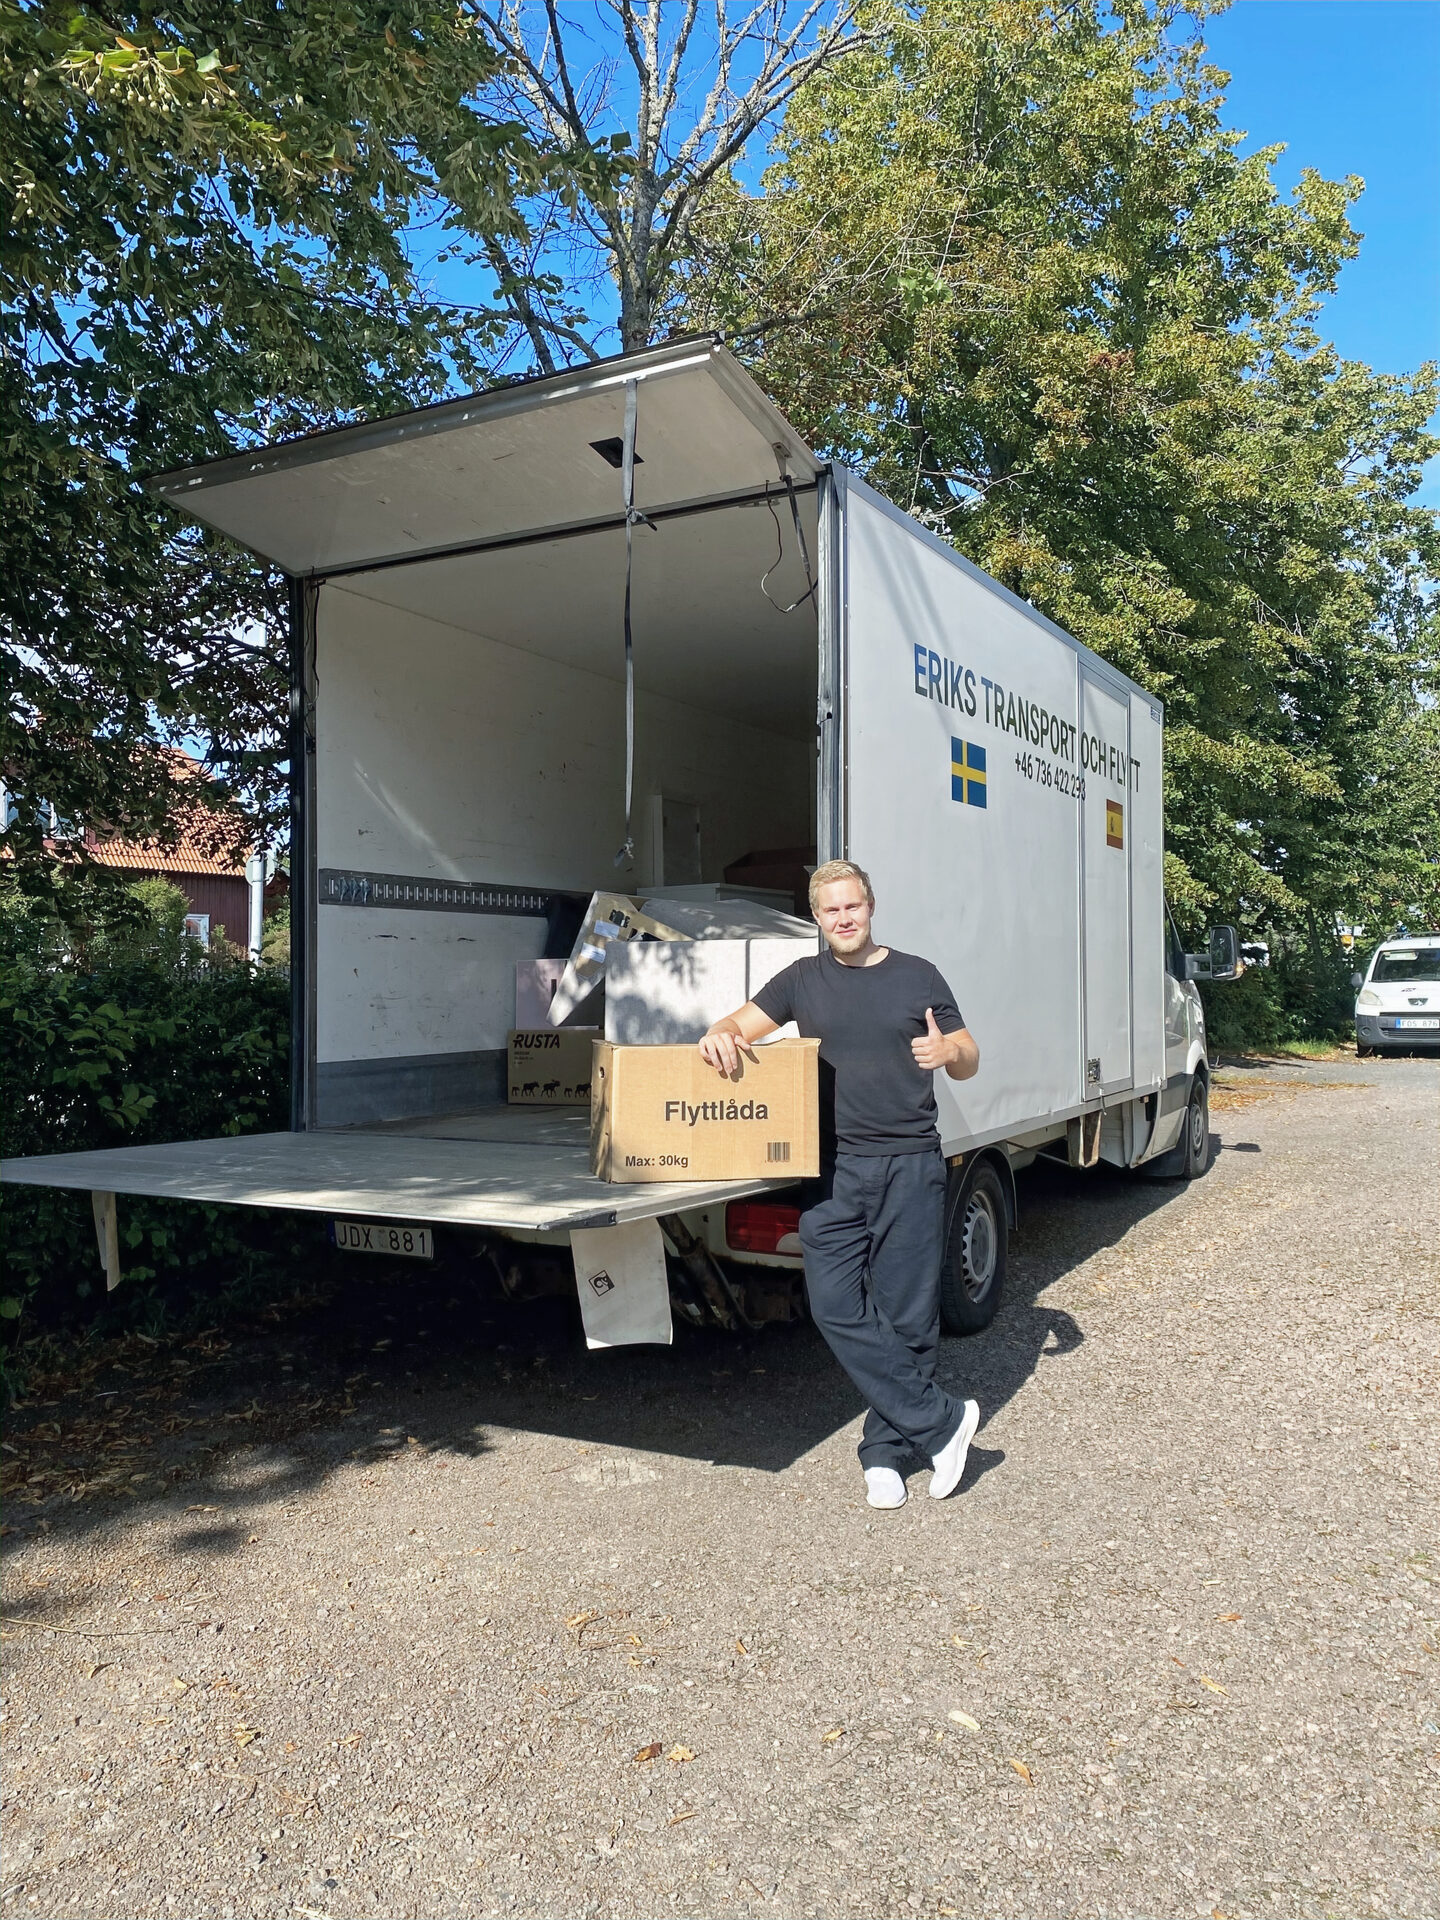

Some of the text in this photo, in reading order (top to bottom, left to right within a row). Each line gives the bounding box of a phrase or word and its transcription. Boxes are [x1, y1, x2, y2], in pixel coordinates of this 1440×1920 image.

[914, 642, 977, 717] ERIKS
[981, 676, 1077, 764] TRANSPORT
[1080, 731, 1107, 778] OCH
[1015, 752, 1086, 801] +46 736 422 293
[513, 1033, 560, 1049] RUSTA
[664, 1098, 769, 1127] Flyttlåda
[625, 1155, 689, 1168] Max: 30kg
[338, 1224, 426, 1255] JDX 881
